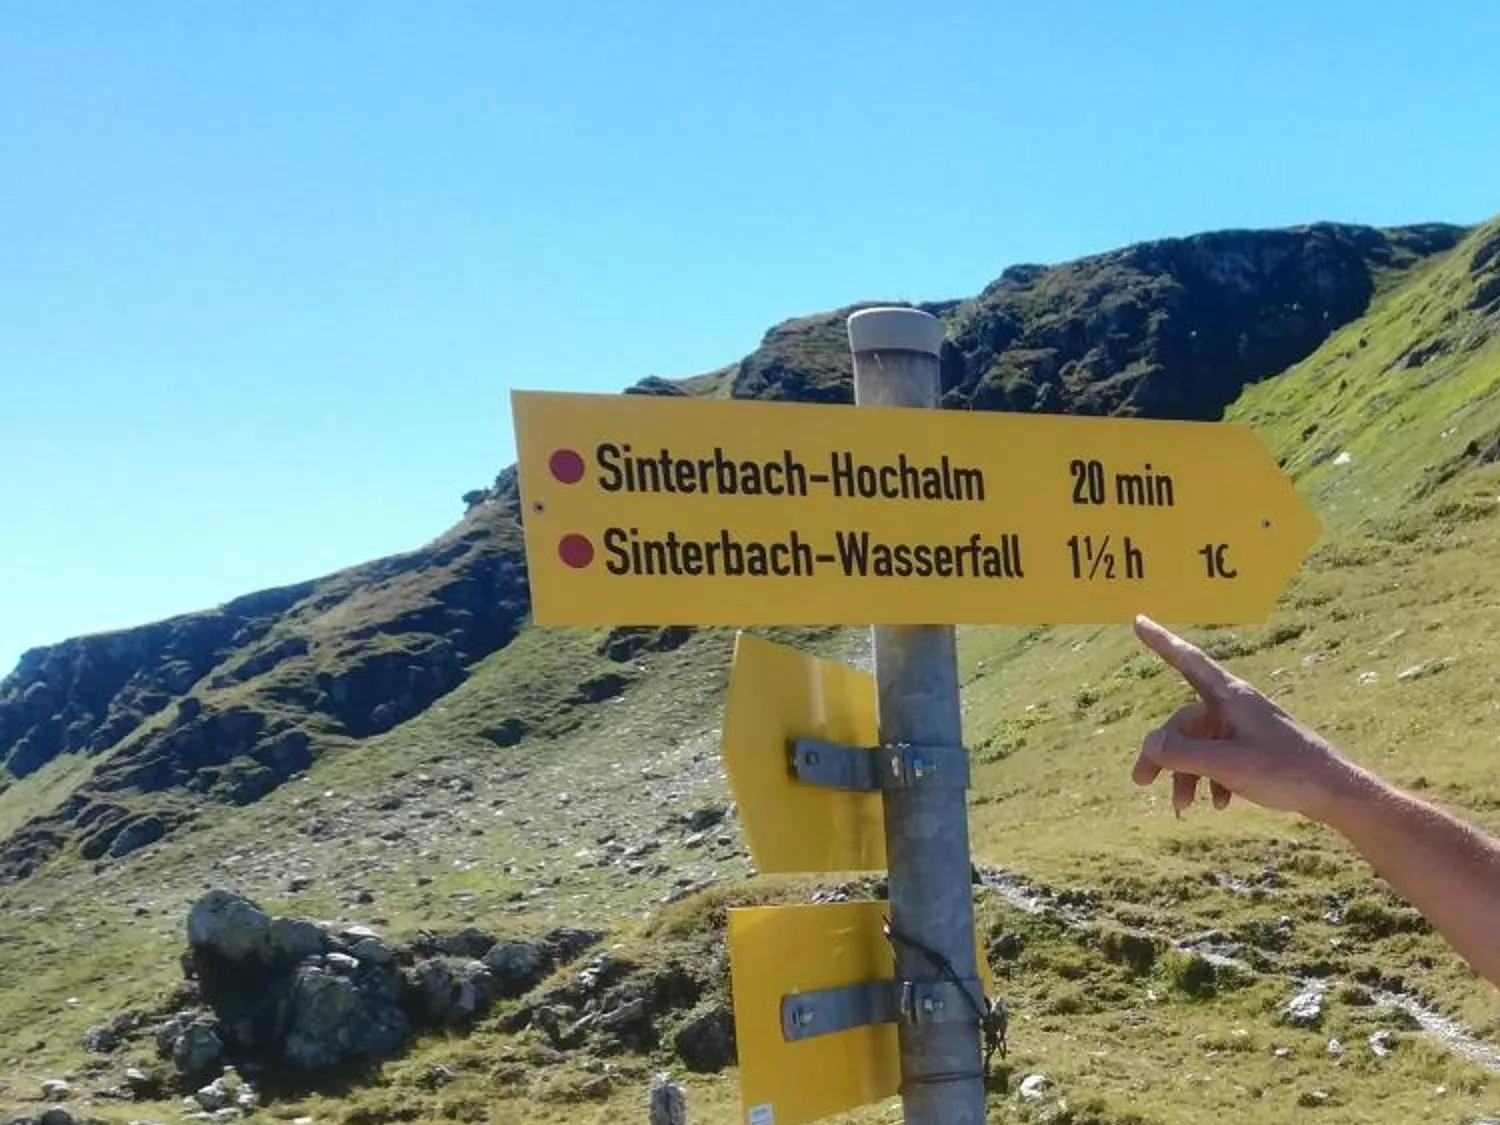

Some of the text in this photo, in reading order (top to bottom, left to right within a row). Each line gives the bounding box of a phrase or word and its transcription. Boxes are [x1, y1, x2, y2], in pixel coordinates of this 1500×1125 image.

[595, 442, 1174, 507] Sinterbach-Hochalm 20 min
[603, 527, 1025, 579] Sinterbach-Wasserfall
[1123, 536, 1144, 579] h
